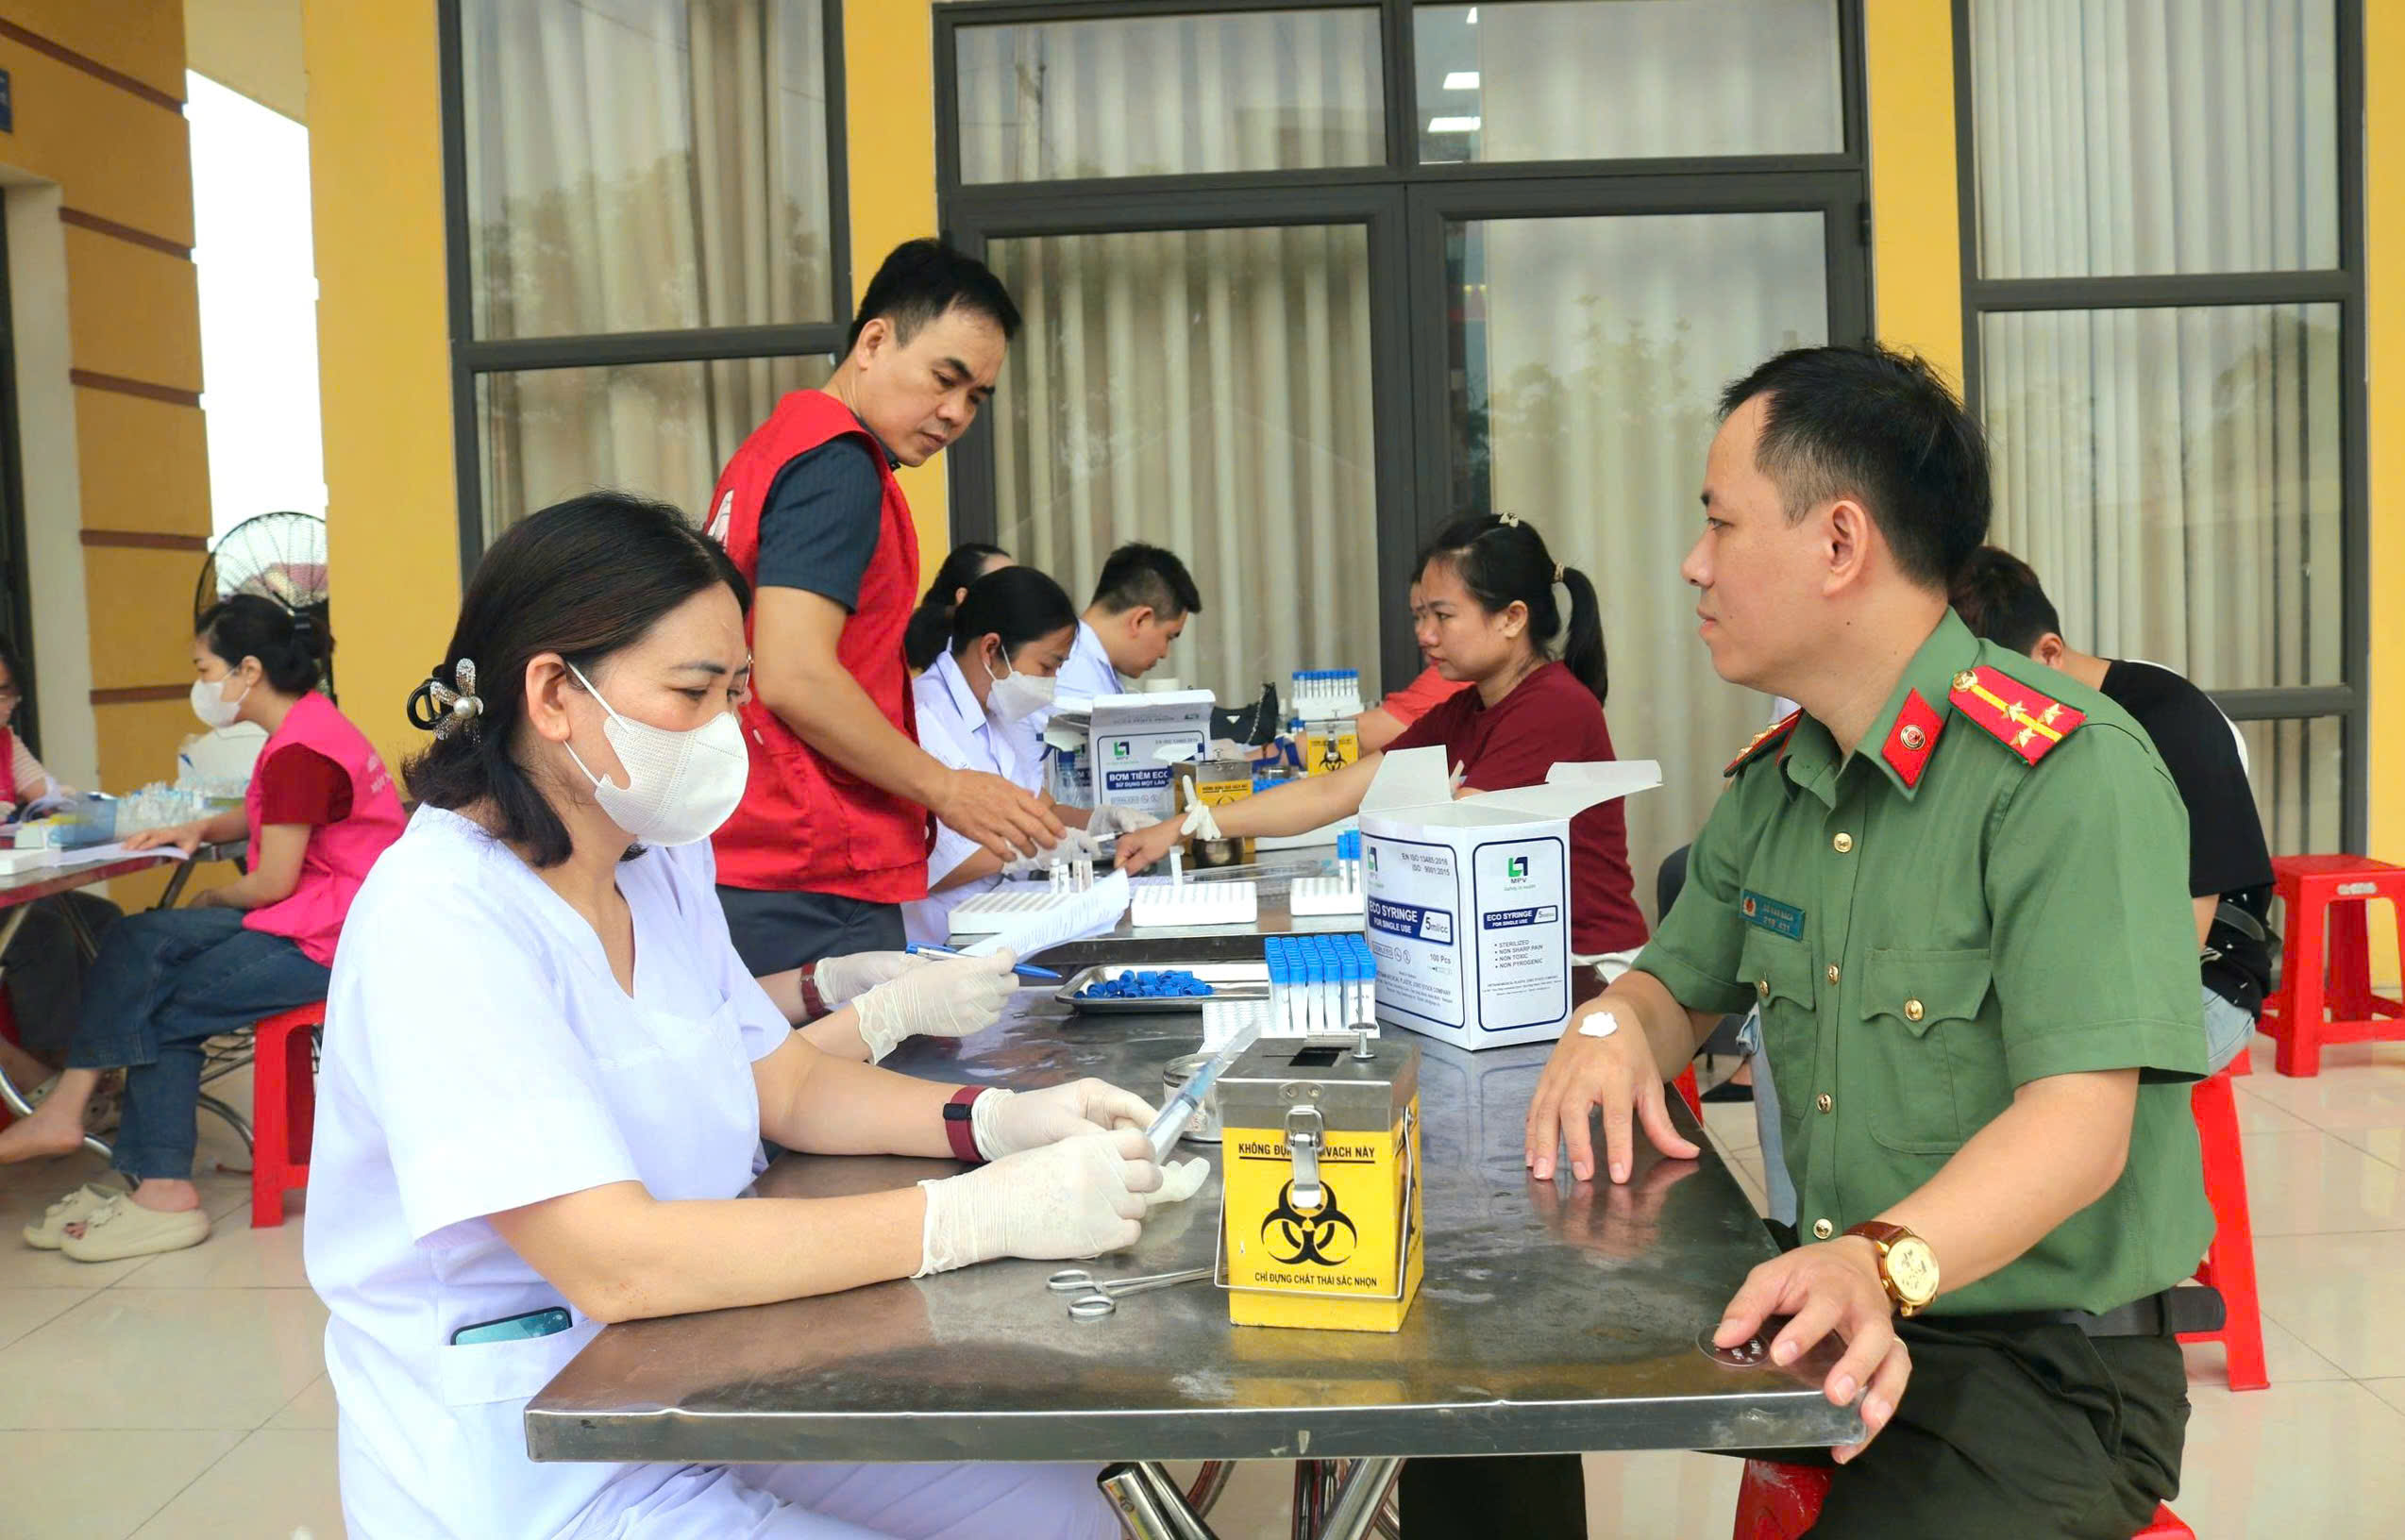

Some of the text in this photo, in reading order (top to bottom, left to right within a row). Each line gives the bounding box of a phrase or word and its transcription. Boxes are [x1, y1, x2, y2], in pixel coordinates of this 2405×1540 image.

[1109, 773, 1130, 782] BƠM
[1132, 771, 1151, 780] TIÊM
[1412, 863, 1421, 872] ISO
[1369, 900, 1381, 915] ECO
[1382, 904, 1418, 923] SYRINGE
[1487, 913, 1502, 922] ECO
[1503, 910, 1533, 920] SYRINGE
[1382, 919, 1400, 931] SINGLE
[1400, 924, 1412, 934] USE
[1499, 939, 1530, 948] STERILIZED
[1430, 953, 1452, 964] 100 Pcs
[1512, 958, 1543, 967] PYROGENIC
[1238, 1142, 1375, 1160] KHÔNG ĐỰ VẠCH NÀY
[1254, 1270, 1268, 1282] CHỈ
[1270, 1273, 1292, 1284] ĐỰNG
[1354, 1277, 1377, 1289] NHỌN
